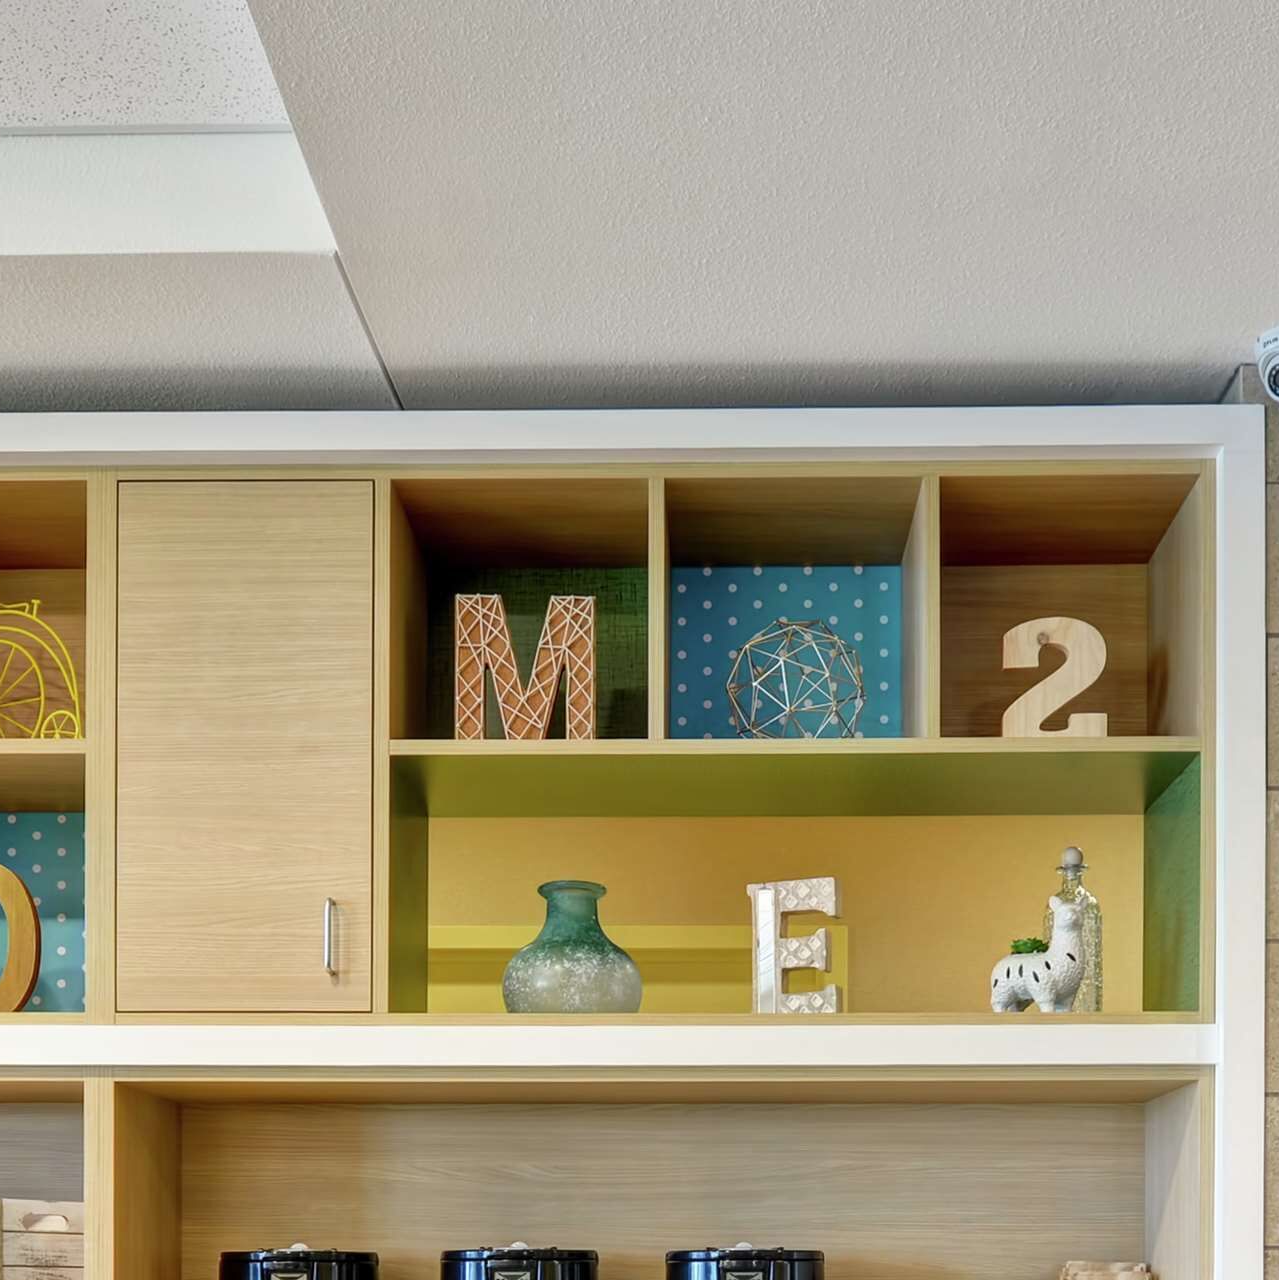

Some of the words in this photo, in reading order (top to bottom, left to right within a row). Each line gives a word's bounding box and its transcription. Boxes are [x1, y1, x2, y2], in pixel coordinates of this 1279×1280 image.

[454, 594, 597, 740] M
[1001, 616, 1108, 738] 2
[747, 877, 844, 1013] E
